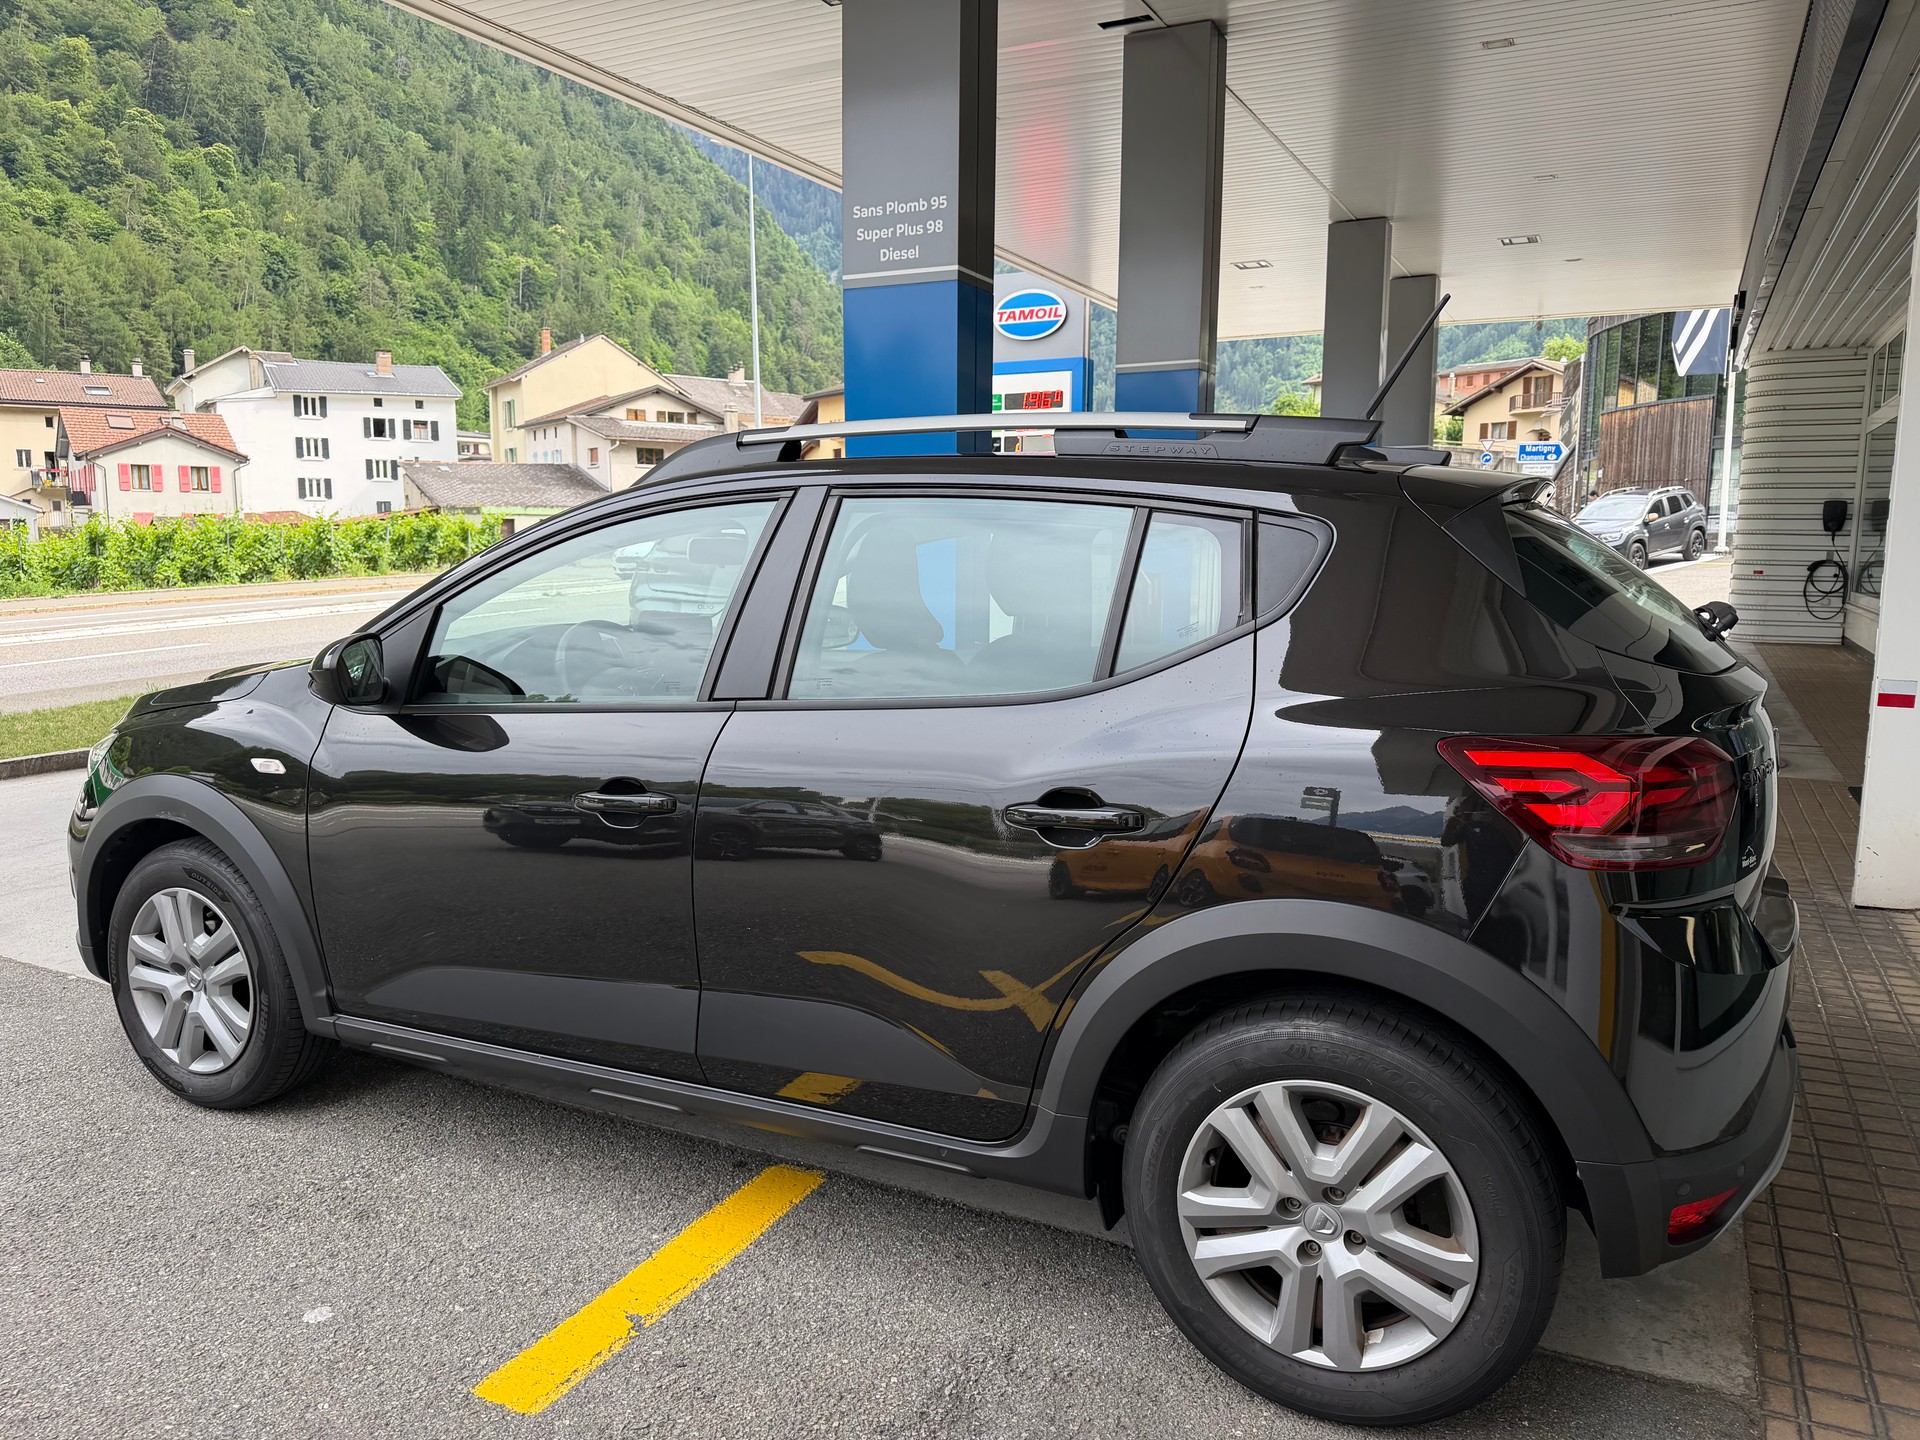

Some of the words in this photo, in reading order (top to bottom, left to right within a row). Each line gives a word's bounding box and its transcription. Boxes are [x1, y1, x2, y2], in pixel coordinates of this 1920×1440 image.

[853, 205, 883, 219] Sans
[886, 198, 928, 215] Plomb
[930, 195, 948, 210] 95
[856, 227, 894, 243] Super
[896, 223, 924, 237] Plus
[926, 219, 943, 234] 98
[880, 245, 919, 262] Diesel
[996, 306, 1063, 323] TAMOIL
[1109, 445, 1212, 455] STEPWAY
[1520, 453, 1545, 461] Chamonix
[1525, 445, 1556, 454] Martigny
[190, 872, 225, 898] OUTSIDE
